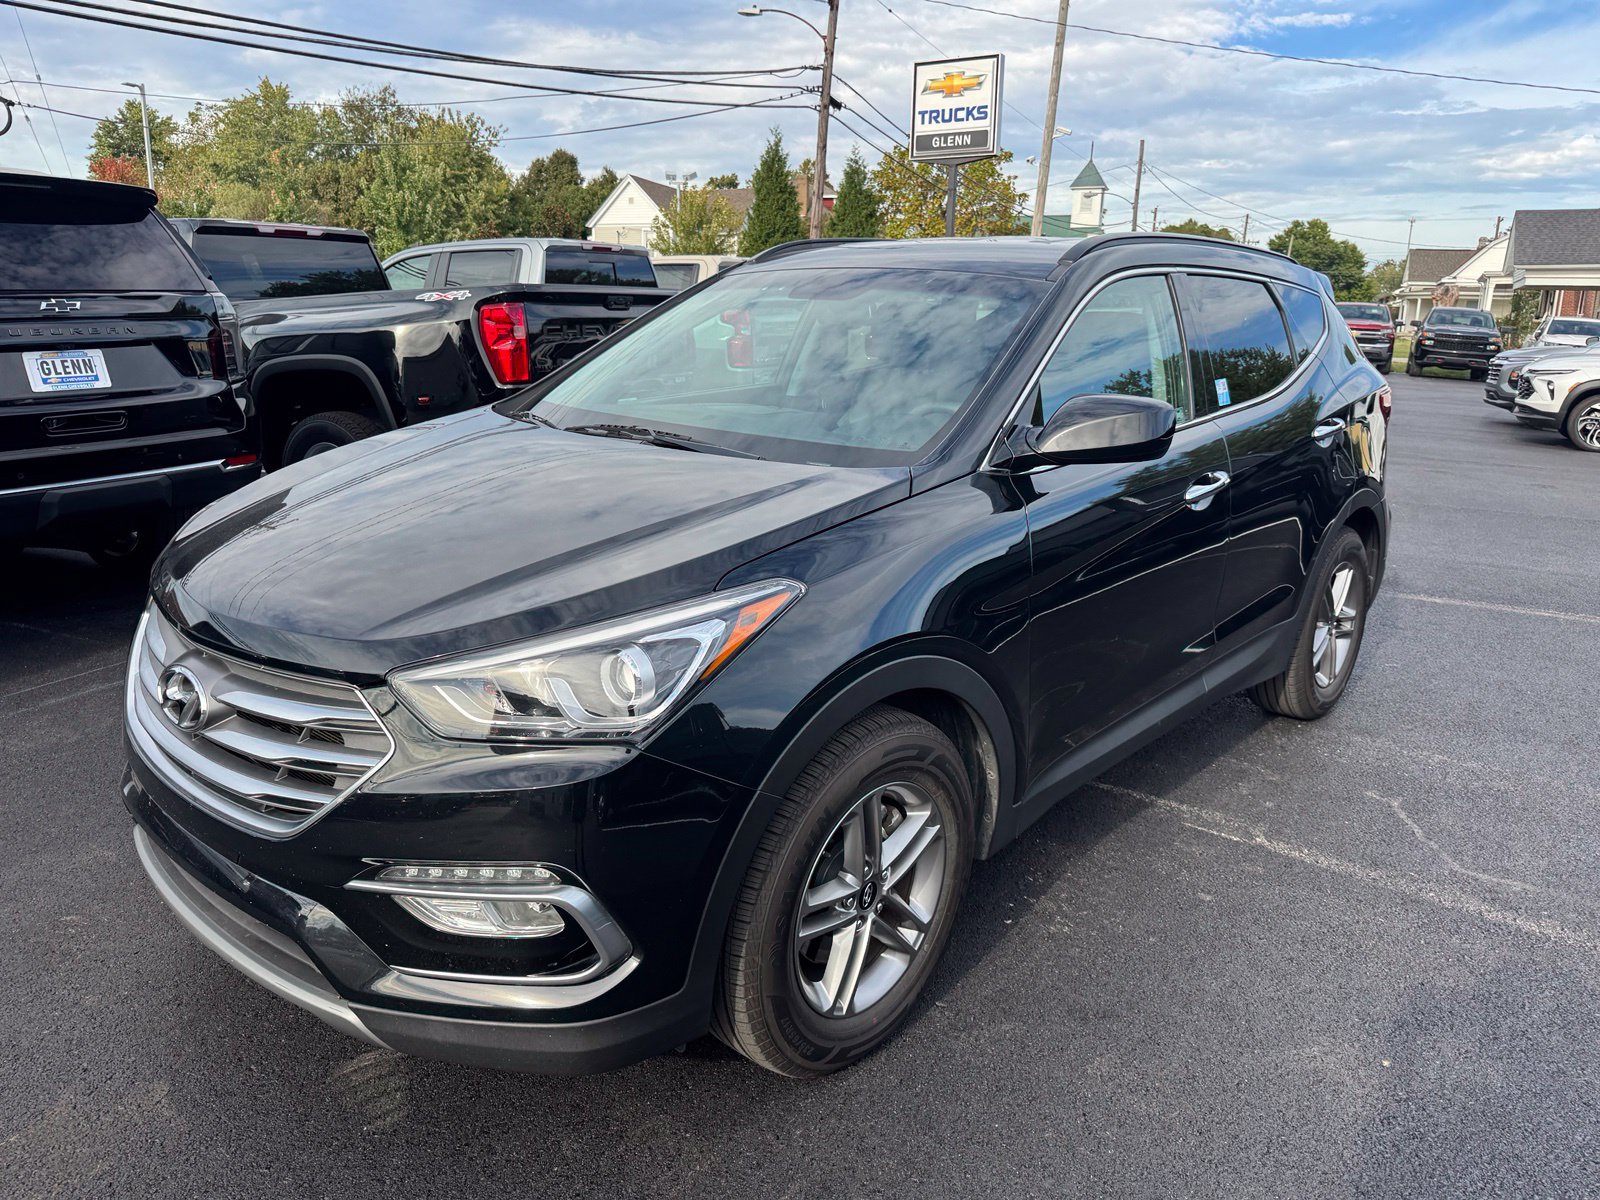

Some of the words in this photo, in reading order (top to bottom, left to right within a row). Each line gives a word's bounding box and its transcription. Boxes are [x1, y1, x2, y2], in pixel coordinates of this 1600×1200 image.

[918, 104, 988, 125] TRUCKS
[932, 134, 971, 147] GLENN
[543, 322, 620, 341] CHEV
[40, 359, 94, 376] GLENN
